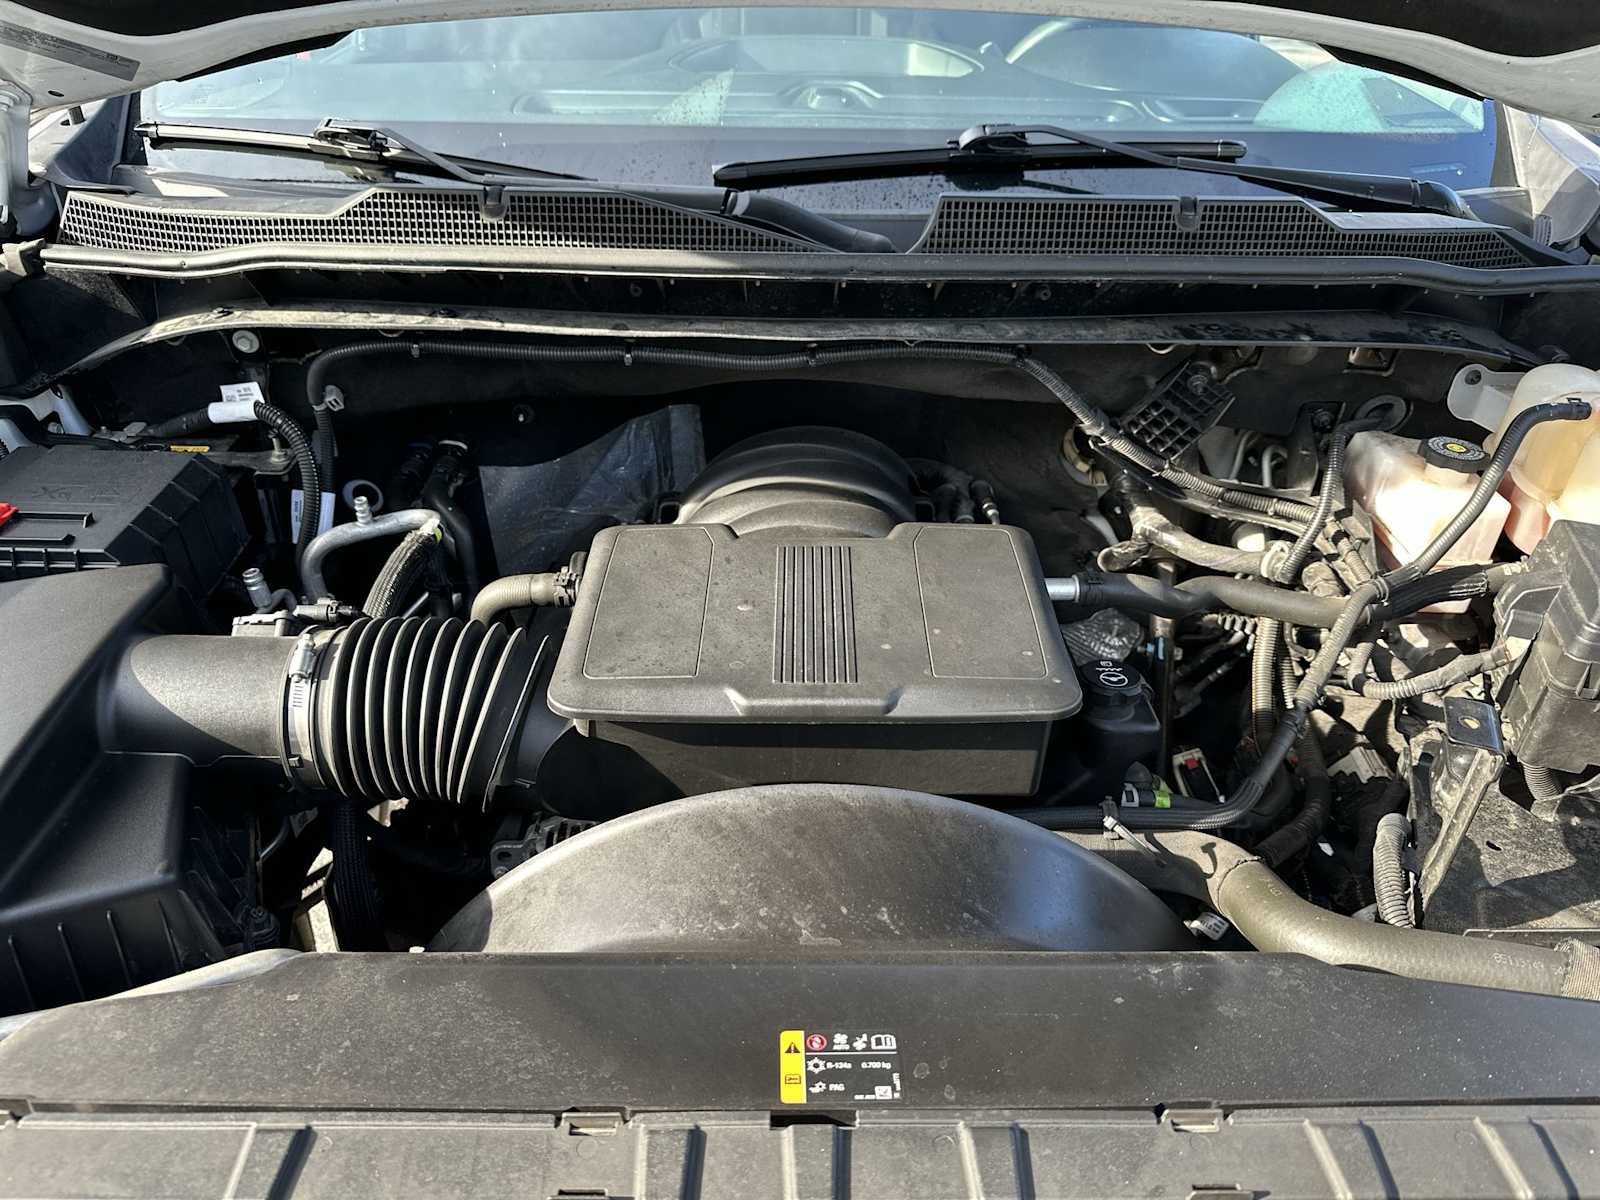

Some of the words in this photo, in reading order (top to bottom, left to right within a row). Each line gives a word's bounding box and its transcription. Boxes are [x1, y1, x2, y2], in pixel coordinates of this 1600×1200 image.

[826, 1061, 852, 1069] R-134a
[881, 1061, 892, 1069] kg
[828, 1083, 845, 1091] PAG
